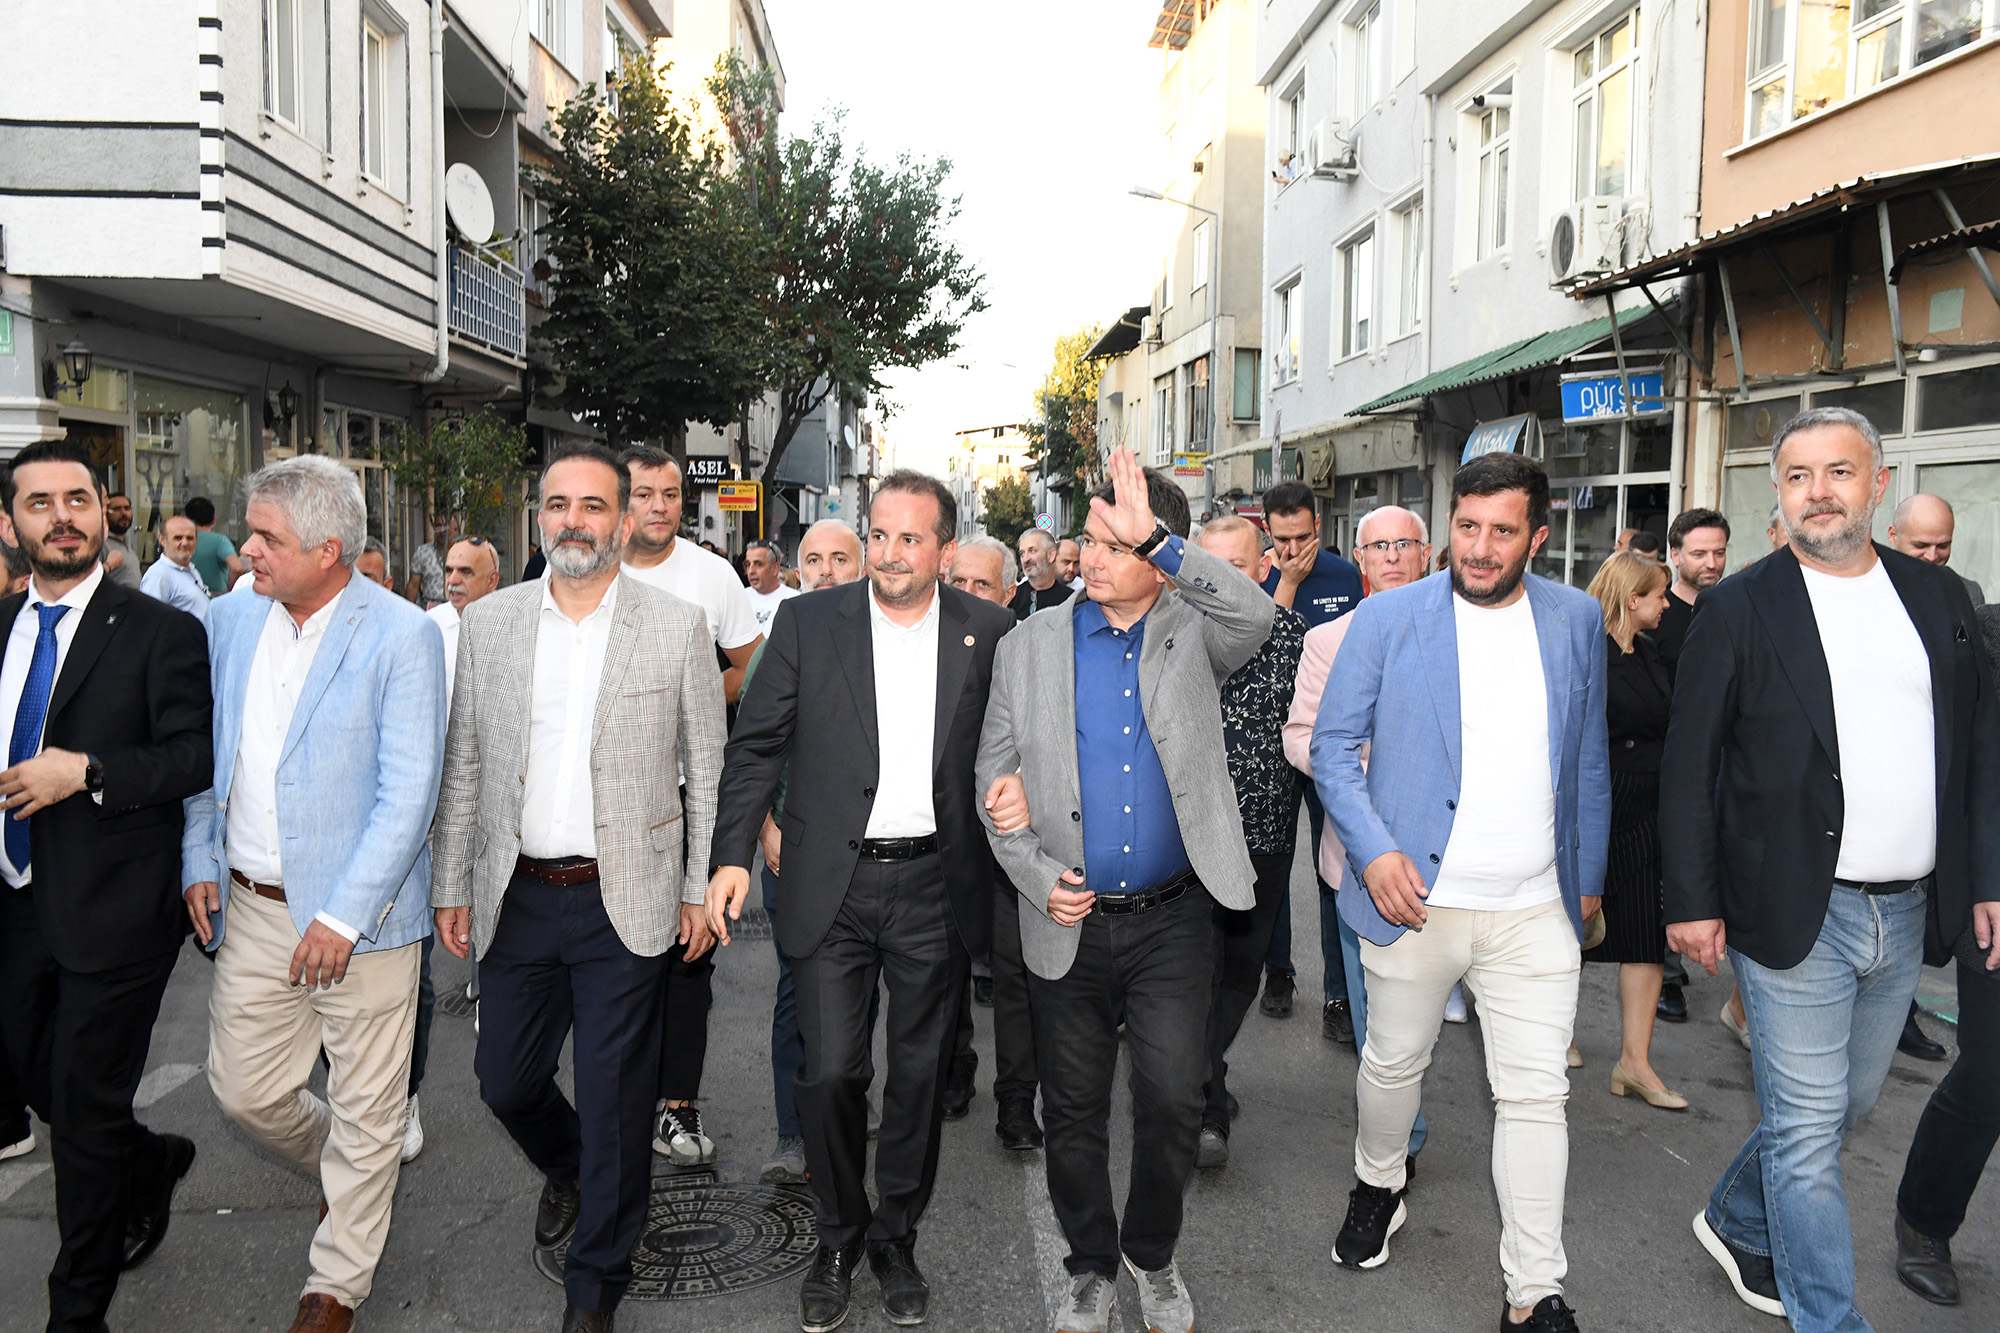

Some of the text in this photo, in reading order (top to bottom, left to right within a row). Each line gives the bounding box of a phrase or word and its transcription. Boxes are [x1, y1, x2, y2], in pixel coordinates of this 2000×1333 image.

[1580, 381, 1646, 414] pürsu
[1468, 425, 1517, 458] AYGAZ
[687, 460, 727, 476] ASEL
